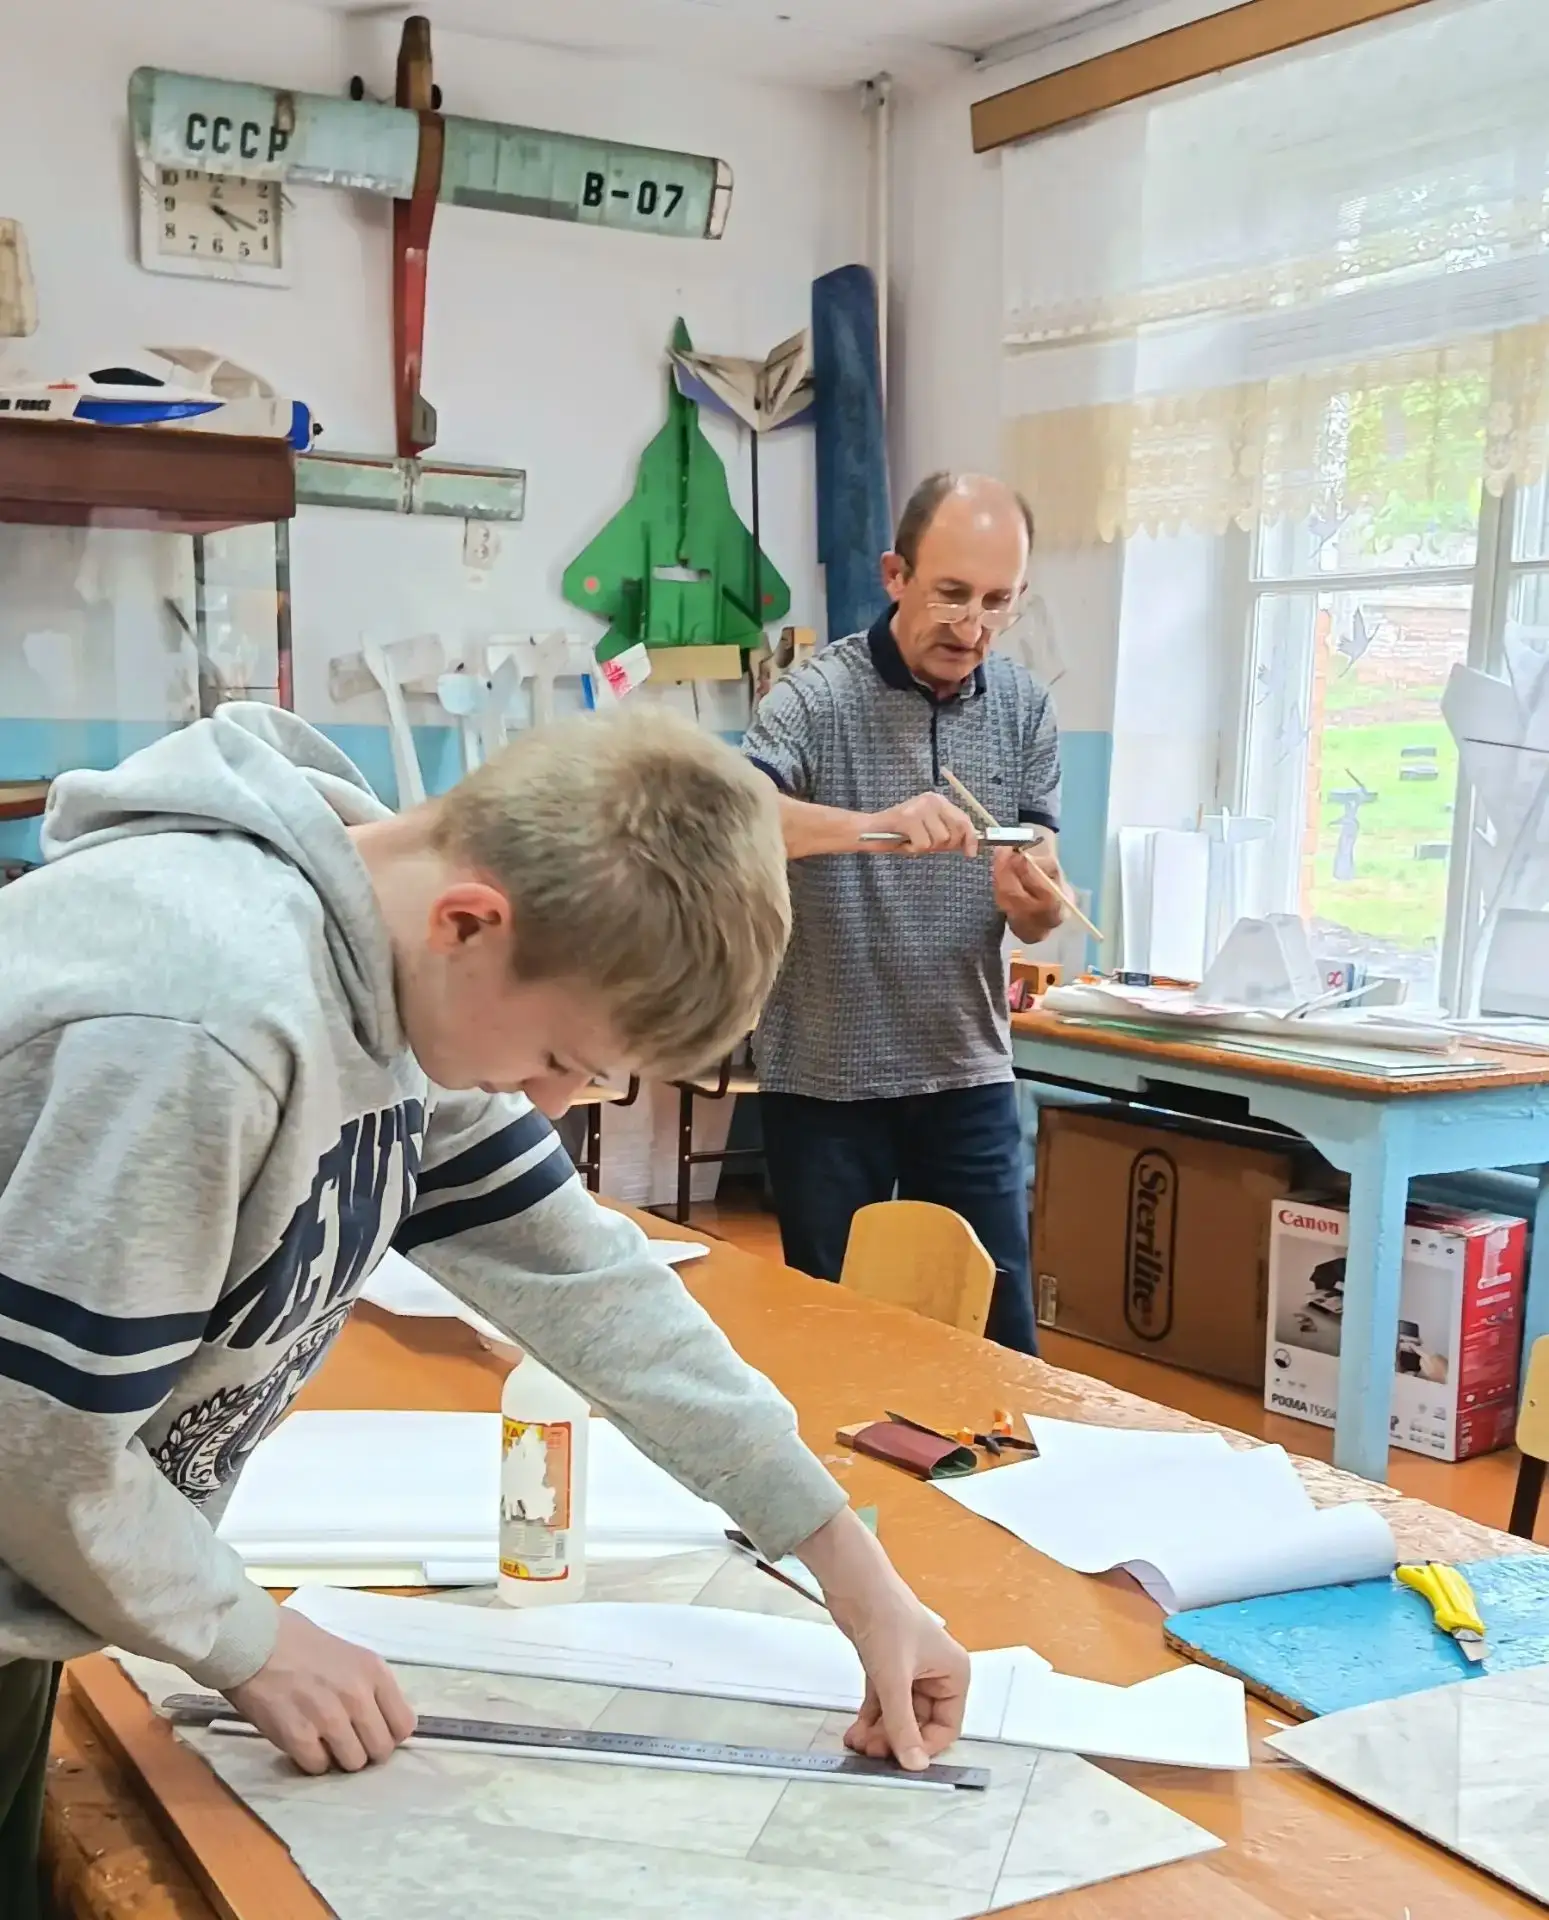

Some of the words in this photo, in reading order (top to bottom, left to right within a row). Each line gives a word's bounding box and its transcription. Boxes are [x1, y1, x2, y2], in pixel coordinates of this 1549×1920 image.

[186, 112, 288, 162] СССР
[582, 171, 684, 218] В-07
[164, 196, 176, 212] 9
[258, 209, 269, 225] 3
[165, 223, 176, 239] 8
[188, 234, 199, 250] 7
[212, 238, 224, 254] 6
[239, 241, 251, 257] 5
[1278, 1209, 1340, 1235] Canon
[1133, 1164, 1168, 1314] Sterilite
[1271, 1393, 1308, 1413] PIXMA
